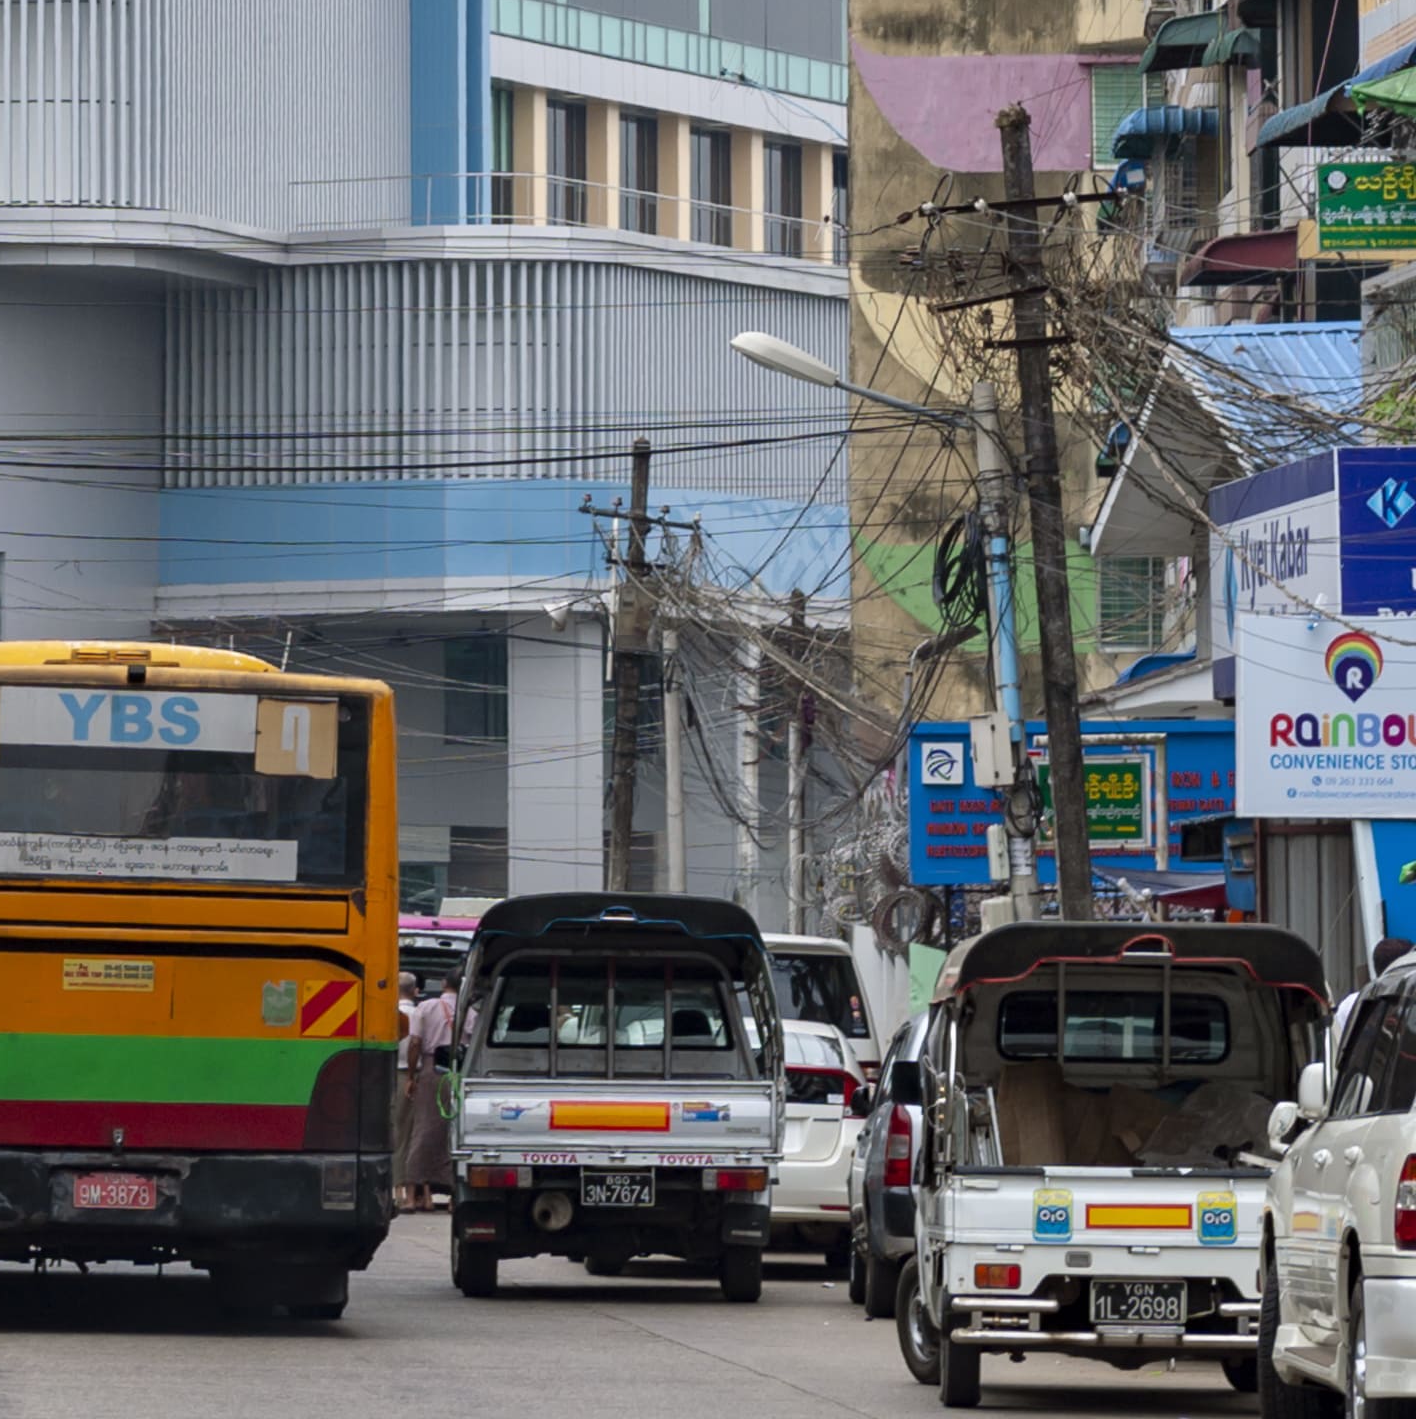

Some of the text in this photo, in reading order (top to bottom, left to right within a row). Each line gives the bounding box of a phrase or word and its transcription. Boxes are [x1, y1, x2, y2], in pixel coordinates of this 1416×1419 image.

[1271, 515, 1310, 582] Kabar
[1345, 666, 1365, 690] R
[58, 693, 202, 745] YBS
[1269, 753, 1385, 770] CONVENIENCE
[521, 1153, 578, 1164] TOYOTA
[658, 1154, 715, 1165] TOYOTA
[80, 1183, 150, 1206] 9M-3878
[586, 1185, 650, 1203] 3N-7674
[1123, 1283, 1155, 1296] YGN
[1095, 1295, 1179, 1320] 1L-2698
